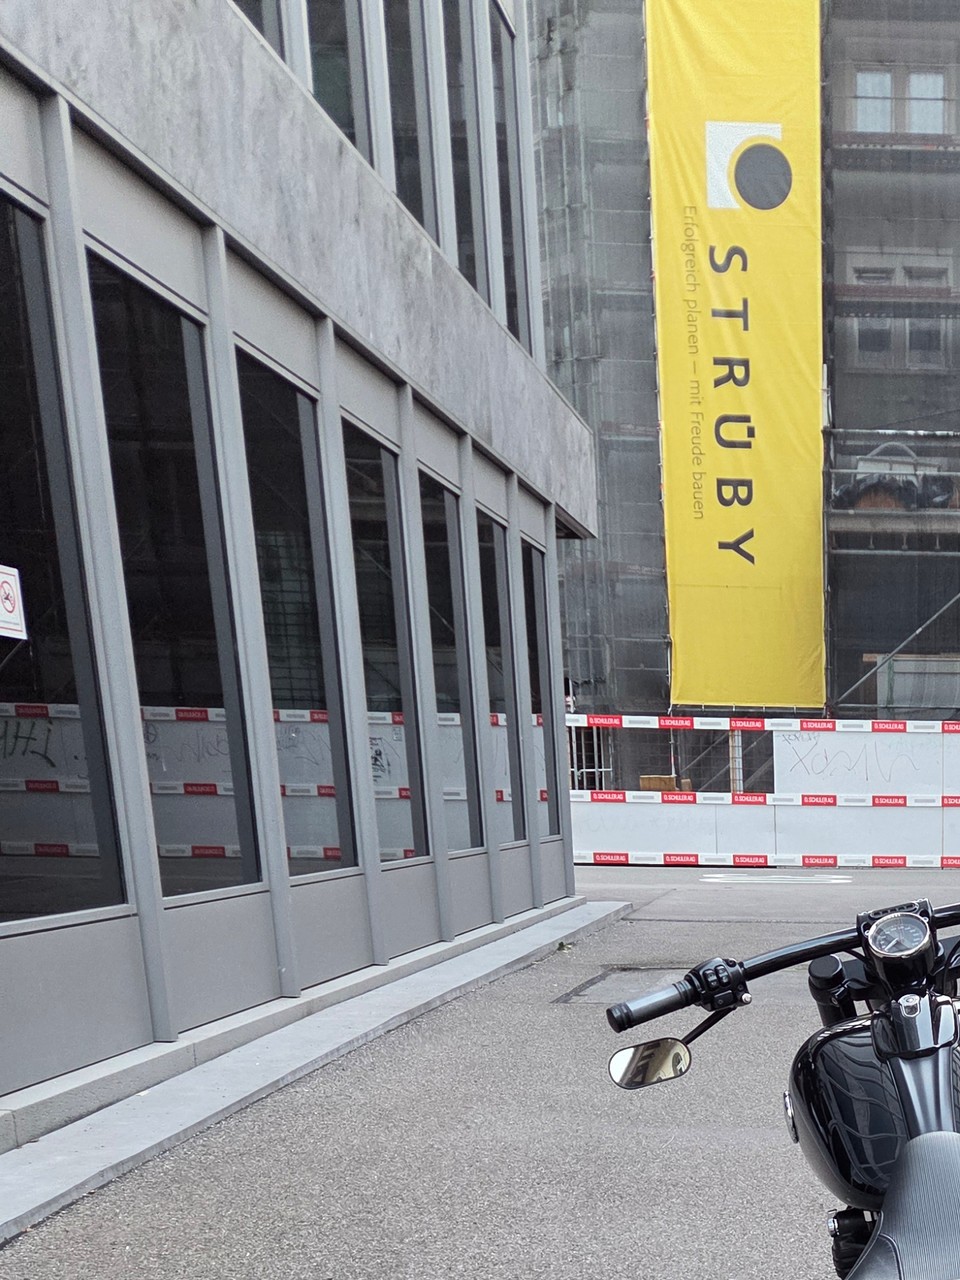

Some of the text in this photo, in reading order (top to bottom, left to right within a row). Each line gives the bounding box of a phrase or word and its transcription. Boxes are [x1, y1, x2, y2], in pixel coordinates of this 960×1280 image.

[681, 205, 701, 292] Erfolgreich
[683, 299, 702, 355] planen
[689, 381, 704, 406] mit
[709, 245, 756, 566] STRÜBY
[690, 412, 706, 467] Freude
[692, 472, 707, 520] bauen
